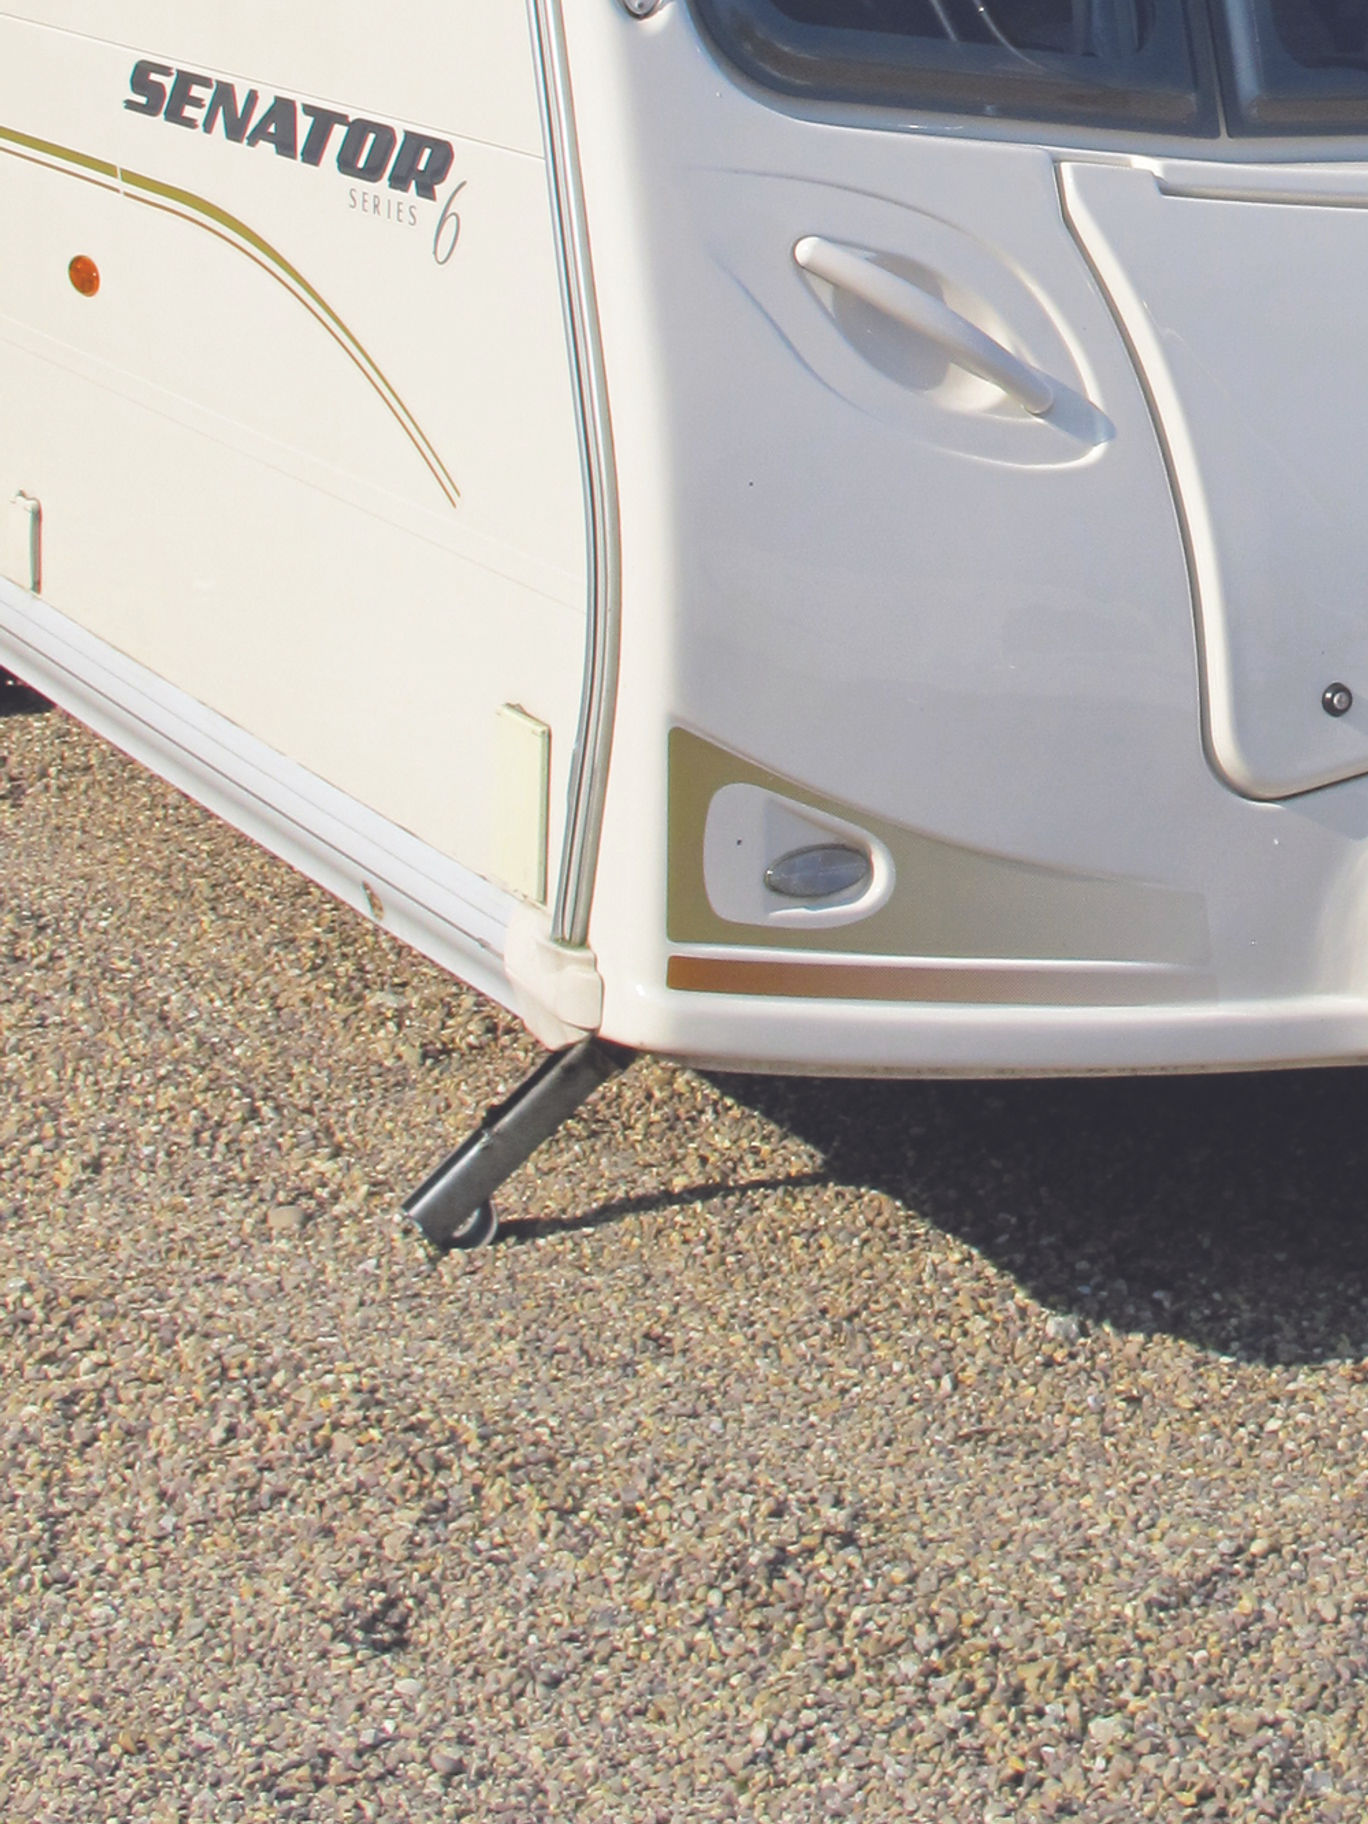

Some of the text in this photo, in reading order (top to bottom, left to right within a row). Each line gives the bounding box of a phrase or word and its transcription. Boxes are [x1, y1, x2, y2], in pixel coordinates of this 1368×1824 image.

[123, 58, 455, 202] SENATOR
[348, 179, 467, 266] SERIES 6
